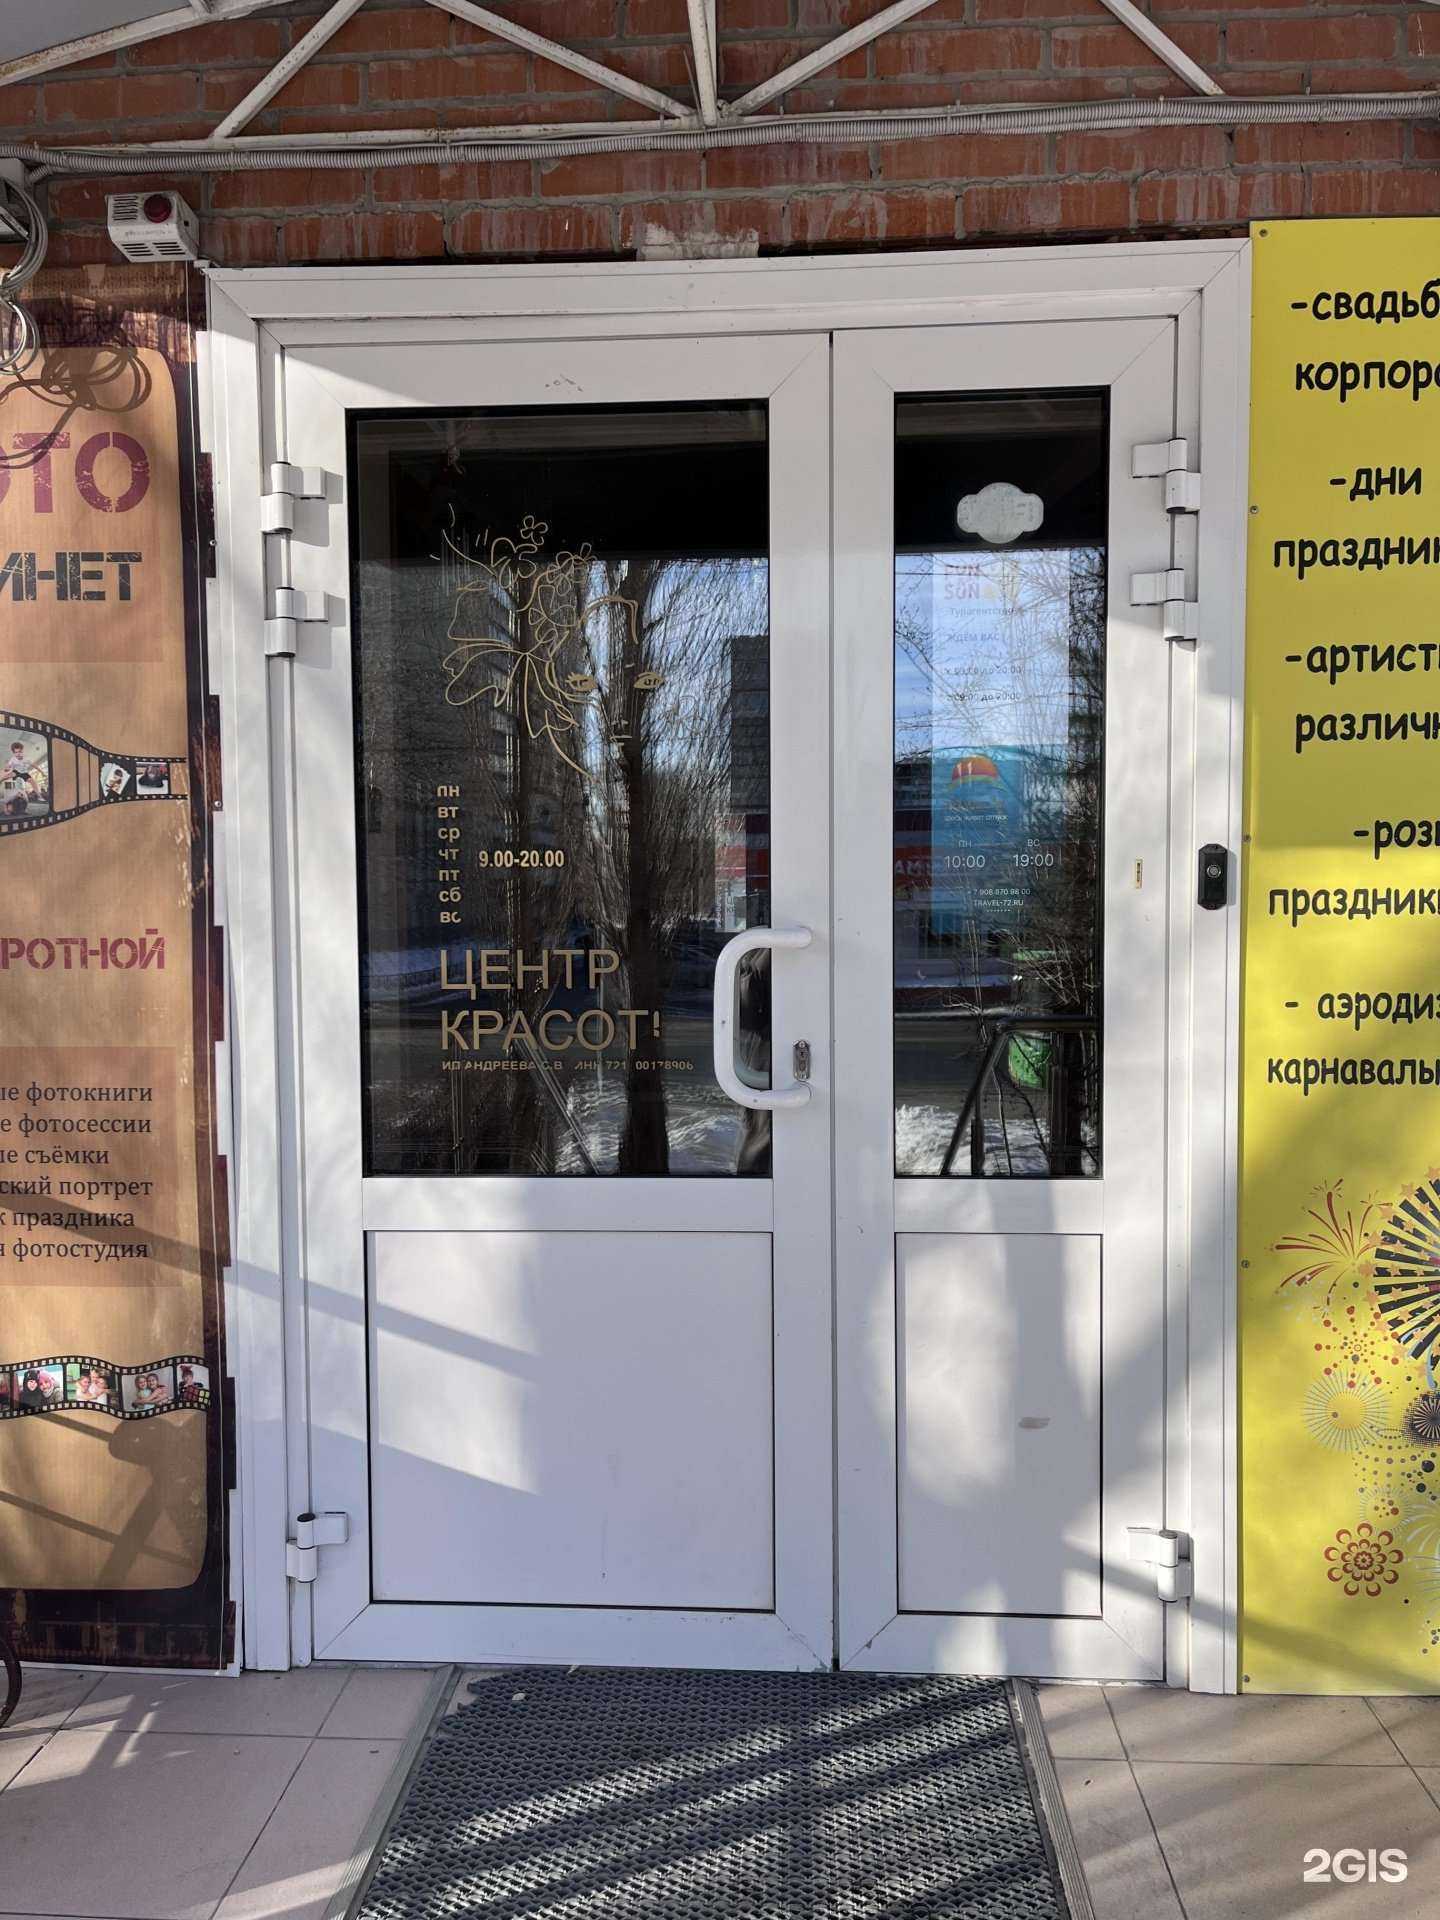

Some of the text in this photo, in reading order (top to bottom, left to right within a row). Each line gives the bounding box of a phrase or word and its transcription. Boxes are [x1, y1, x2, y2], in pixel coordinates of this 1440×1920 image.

[1291, 278, 1440, 324] -свадьб
[1296, 360, 1440, 402] корпор
[0, 432, 150, 513] ТО
[1330, 466, 1422, 502] -дни
[1285, 643, 1440, 685] -артист
[437, 786, 459, 797] пн
[438, 806, 459, 818] вт
[438, 828, 460, 843] ср
[1354, 820, 1440, 860] -роз
[439, 849, 460, 861] чт
[479, 850, 565, 868] 9.00-20.00
[944, 855, 986, 868] 10:00
[1013, 853, 1054, 867] 19:00
[439, 870, 460, 881] пт
[440, 887, 461, 902] сб
[1269, 888, 1440, 927] праздник
[0, 928, 165, 970] РОТНОЙ
[440, 950, 620, 1000] ЦЕНТР
[1318, 992, 1440, 1031] аэроди
[1268, 1057, 1440, 1096] карнаваль
[26, 1081, 153, 1106] фотокниги
[18, 1113, 151, 1138] фотосессии
[25, 1145, 109, 1165] съёмки
[60, 1181, 153, 1200] портрет
[13, 1211, 135, 1232] праздника
[13, 1238, 149, 1262] фотостудия
